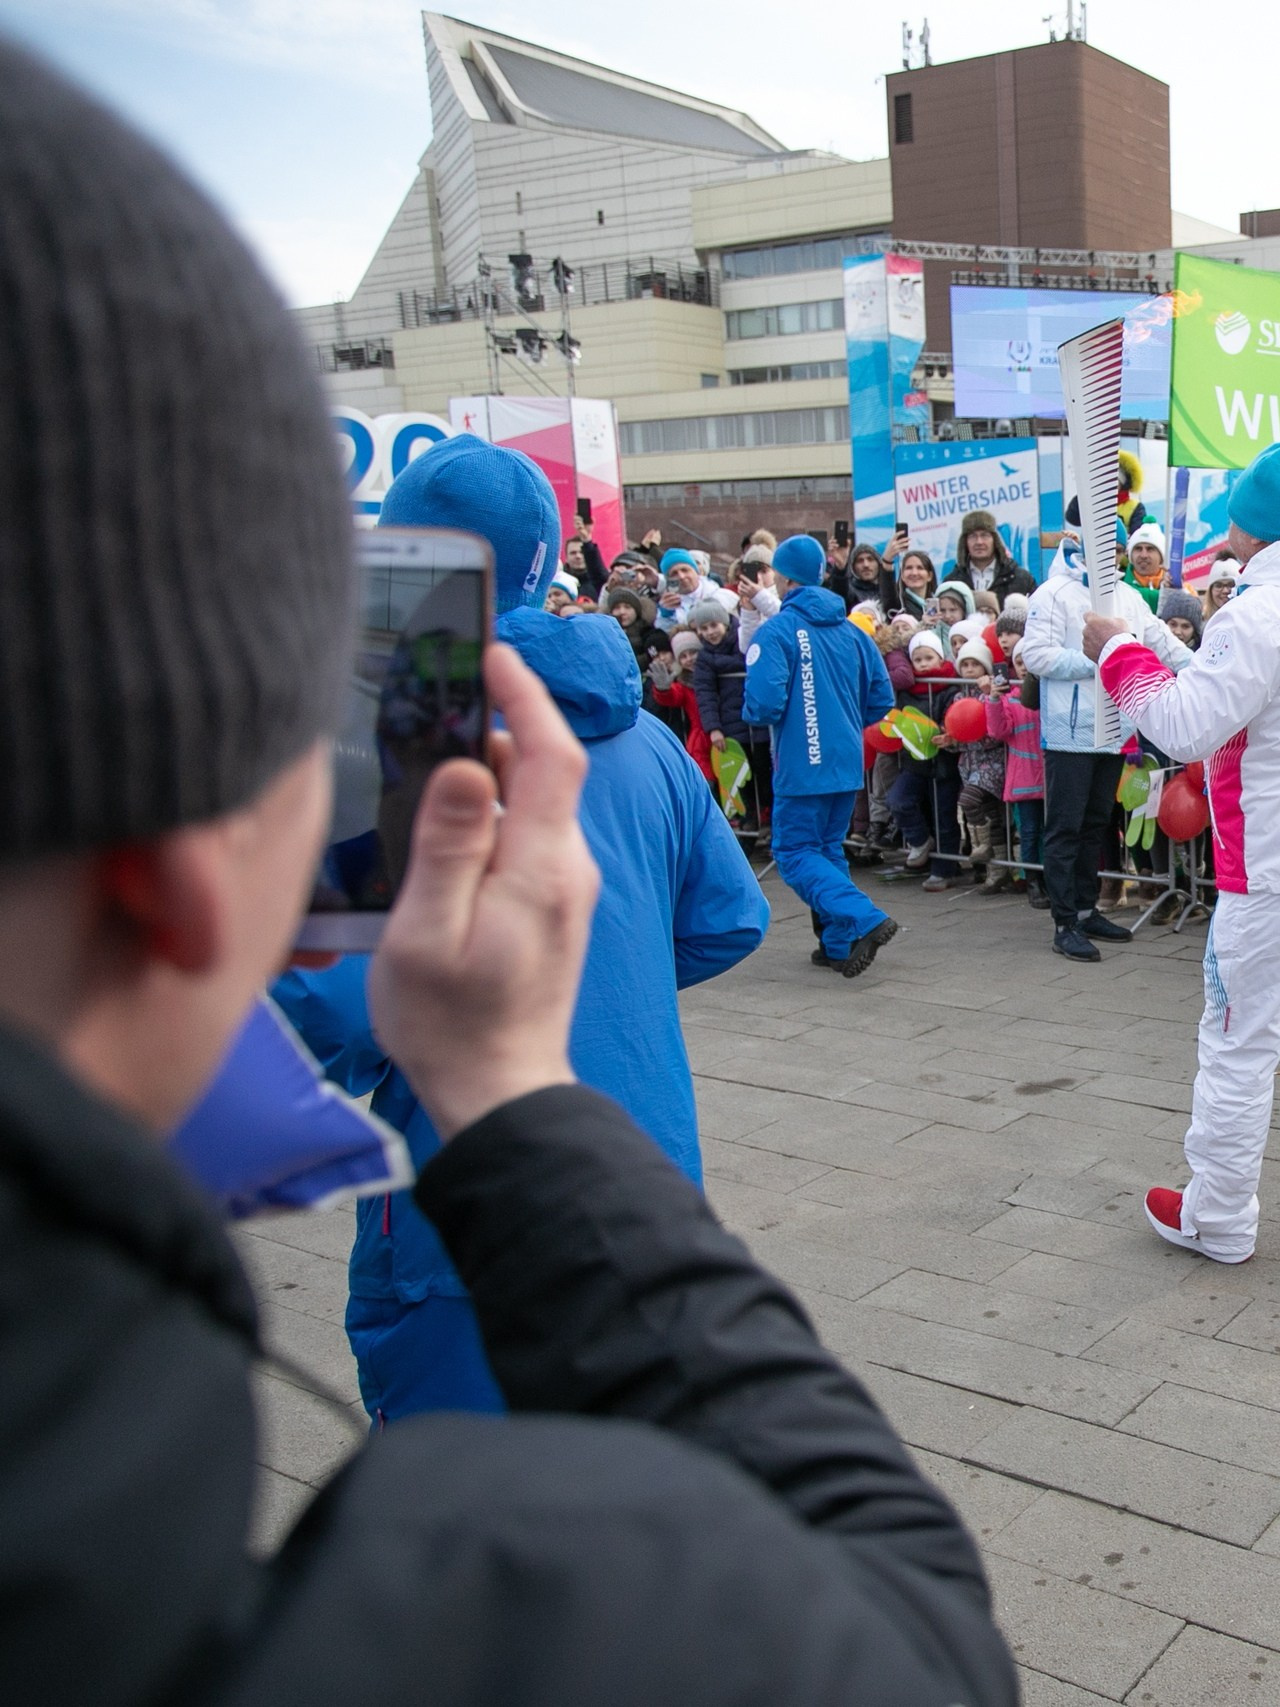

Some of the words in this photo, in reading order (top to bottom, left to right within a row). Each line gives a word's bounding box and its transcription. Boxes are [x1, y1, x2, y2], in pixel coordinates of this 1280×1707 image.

[903, 475, 970, 505] WINTER
[915, 481, 1033, 522] UNIVERSIADE
[796, 629, 811, 659] 2019
[801, 660, 821, 765] KRASNOYARSK
